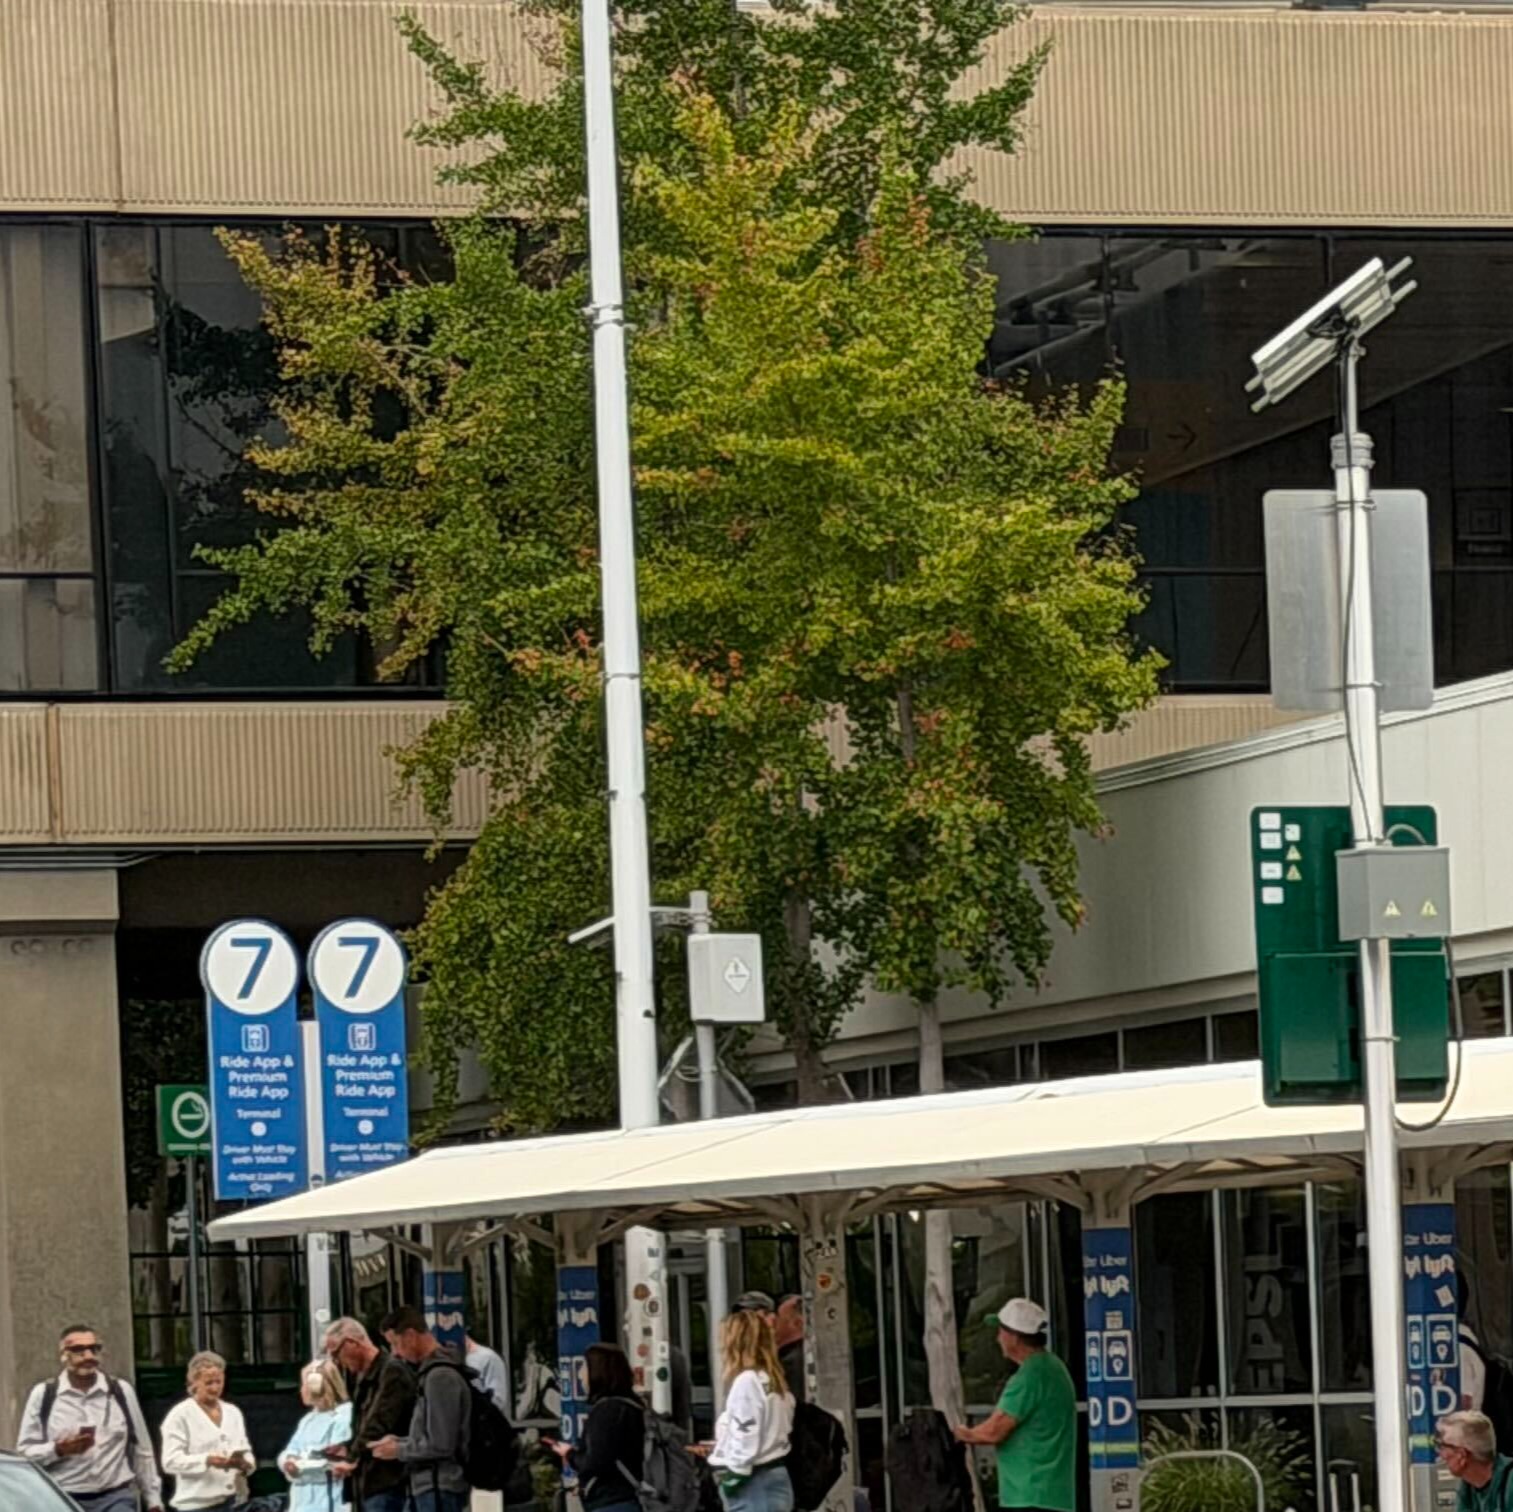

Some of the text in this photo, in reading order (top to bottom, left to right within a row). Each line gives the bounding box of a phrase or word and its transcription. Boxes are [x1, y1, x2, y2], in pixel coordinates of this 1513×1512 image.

[230, 938, 273, 1000] 7
[338, 937, 380, 999] 7
[220, 1054, 295, 1071] Ride App &
[327, 1052, 402, 1068] Ride App &
[228, 1070, 288, 1083] Premium
[335, 1069, 395, 1082] Premium
[228, 1085, 289, 1100] Ride App
[335, 1083, 397, 1099] Ride App
[236, 1108, 281, 1119] Terminal
[343, 1106, 390, 1118] Terminal
[1422, 1231, 1453, 1245] Uber
[1099, 1254, 1128, 1268] Uber
[1431, 1385, 1458, 1417] D
[1107, 1396, 1133, 1426] D
